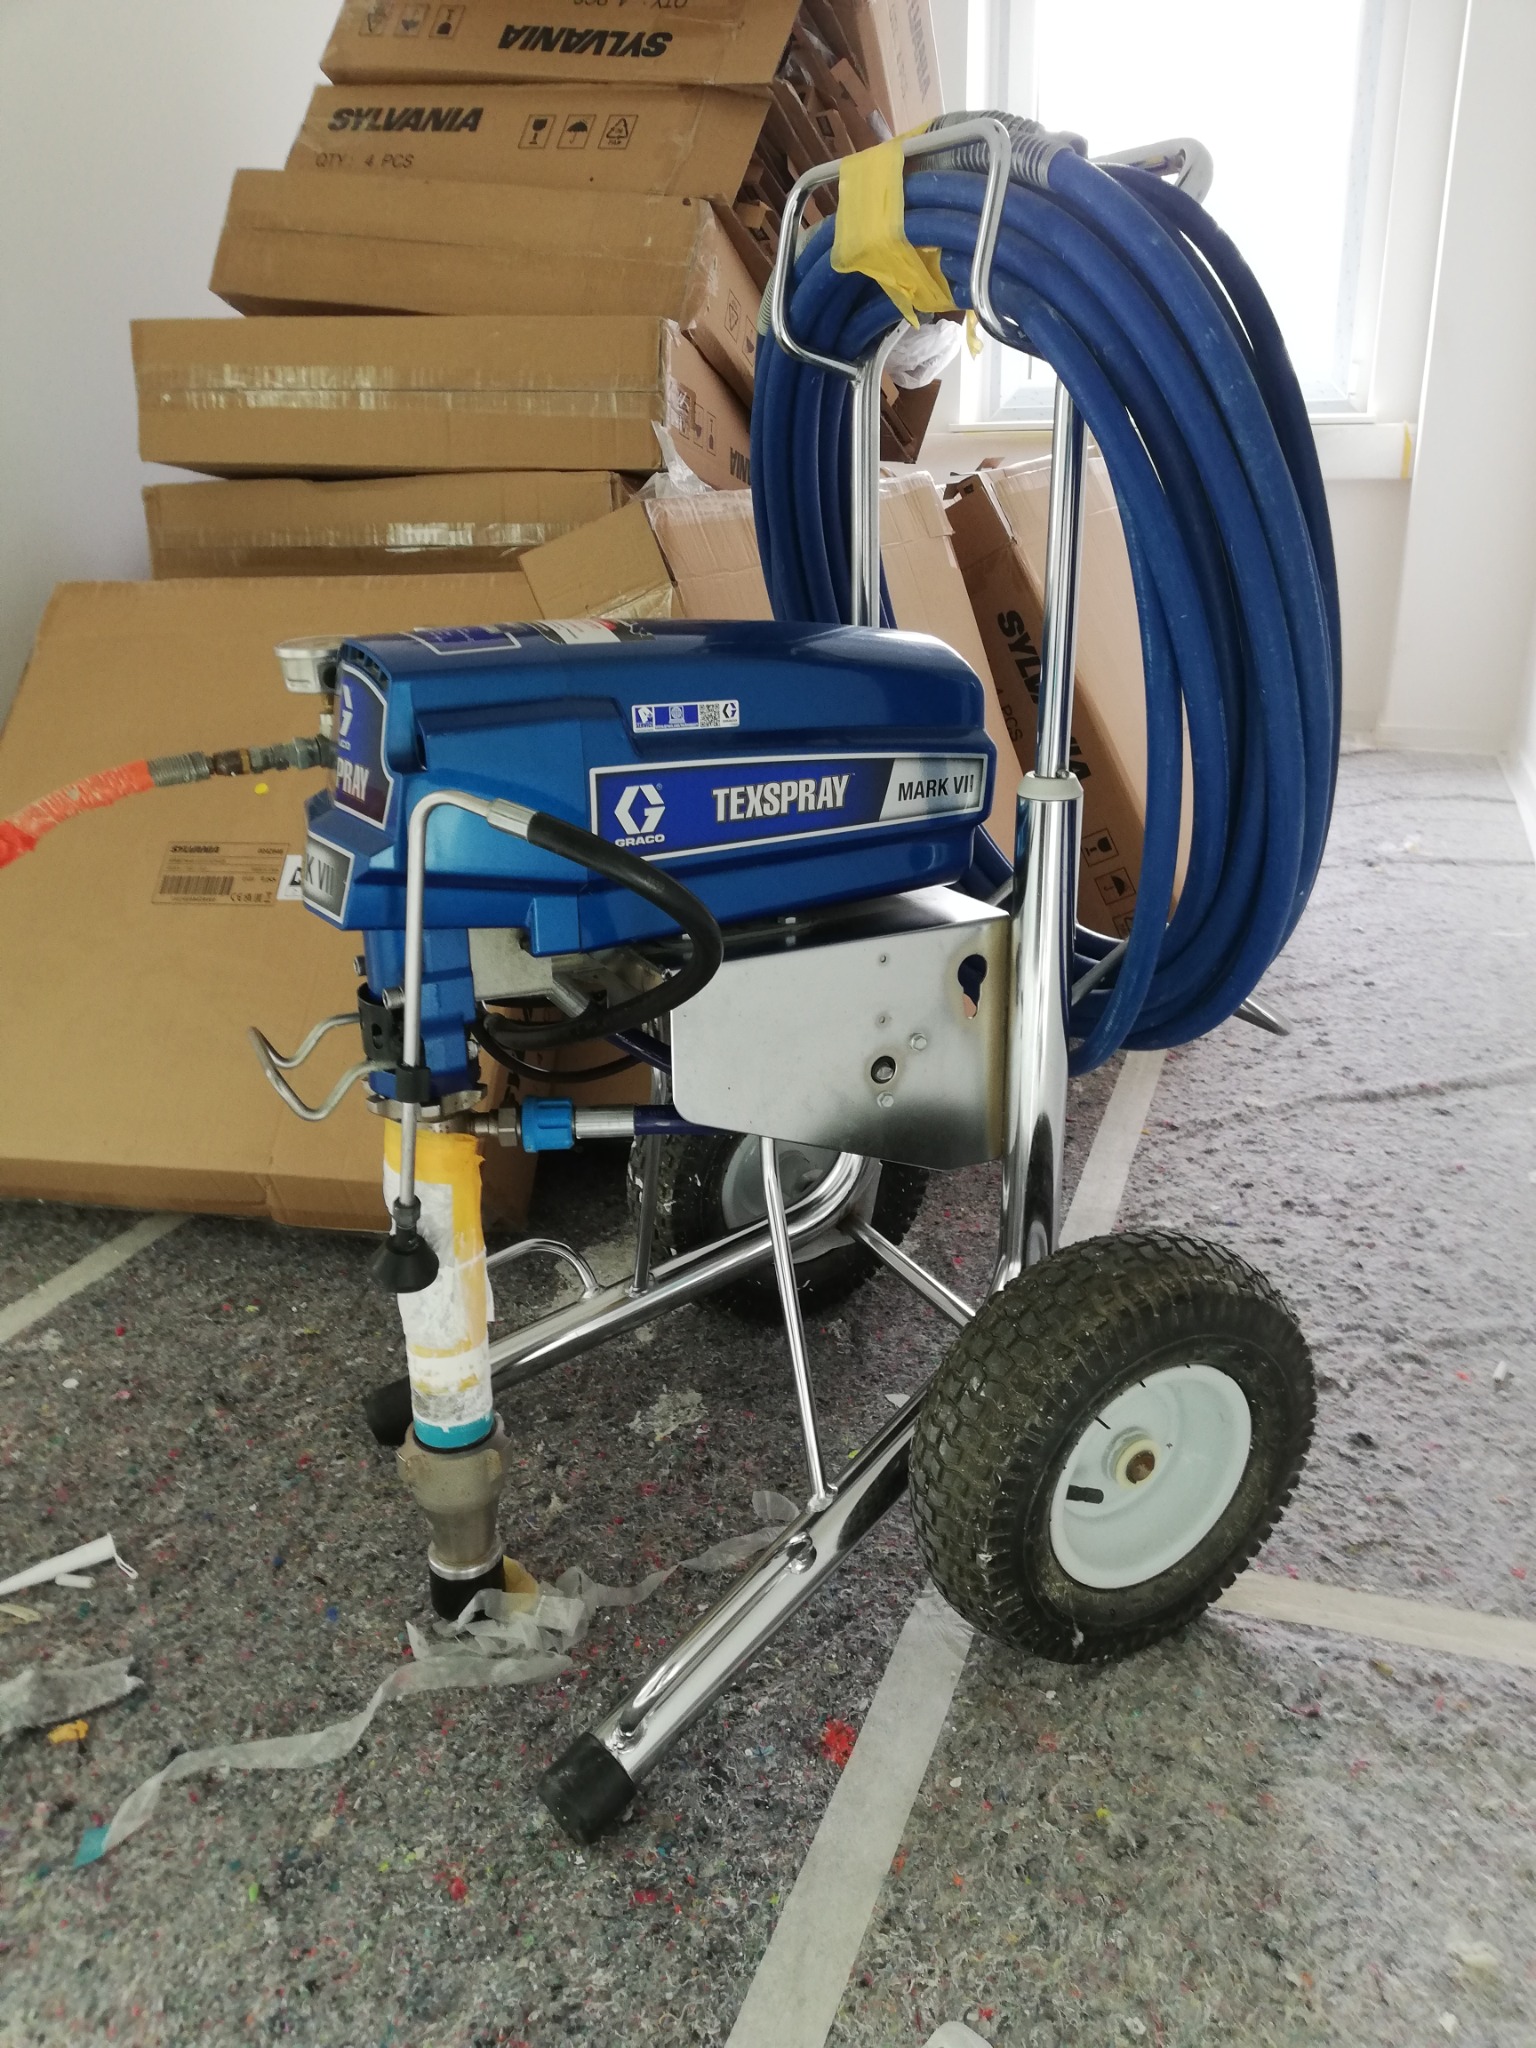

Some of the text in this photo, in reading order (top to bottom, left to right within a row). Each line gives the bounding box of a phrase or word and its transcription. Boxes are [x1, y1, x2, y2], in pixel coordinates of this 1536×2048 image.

[497, 24, 673, 57] SYLVANIA
[328, 107, 484, 132] SYLVANIA
[364, 154, 374, 167] 4
[381, 154, 415, 168] PCS
[712, 774, 850, 822] TEXSPRAY
[898, 774, 974, 802] MARK VII
[614, 834, 665, 847] GRACO
